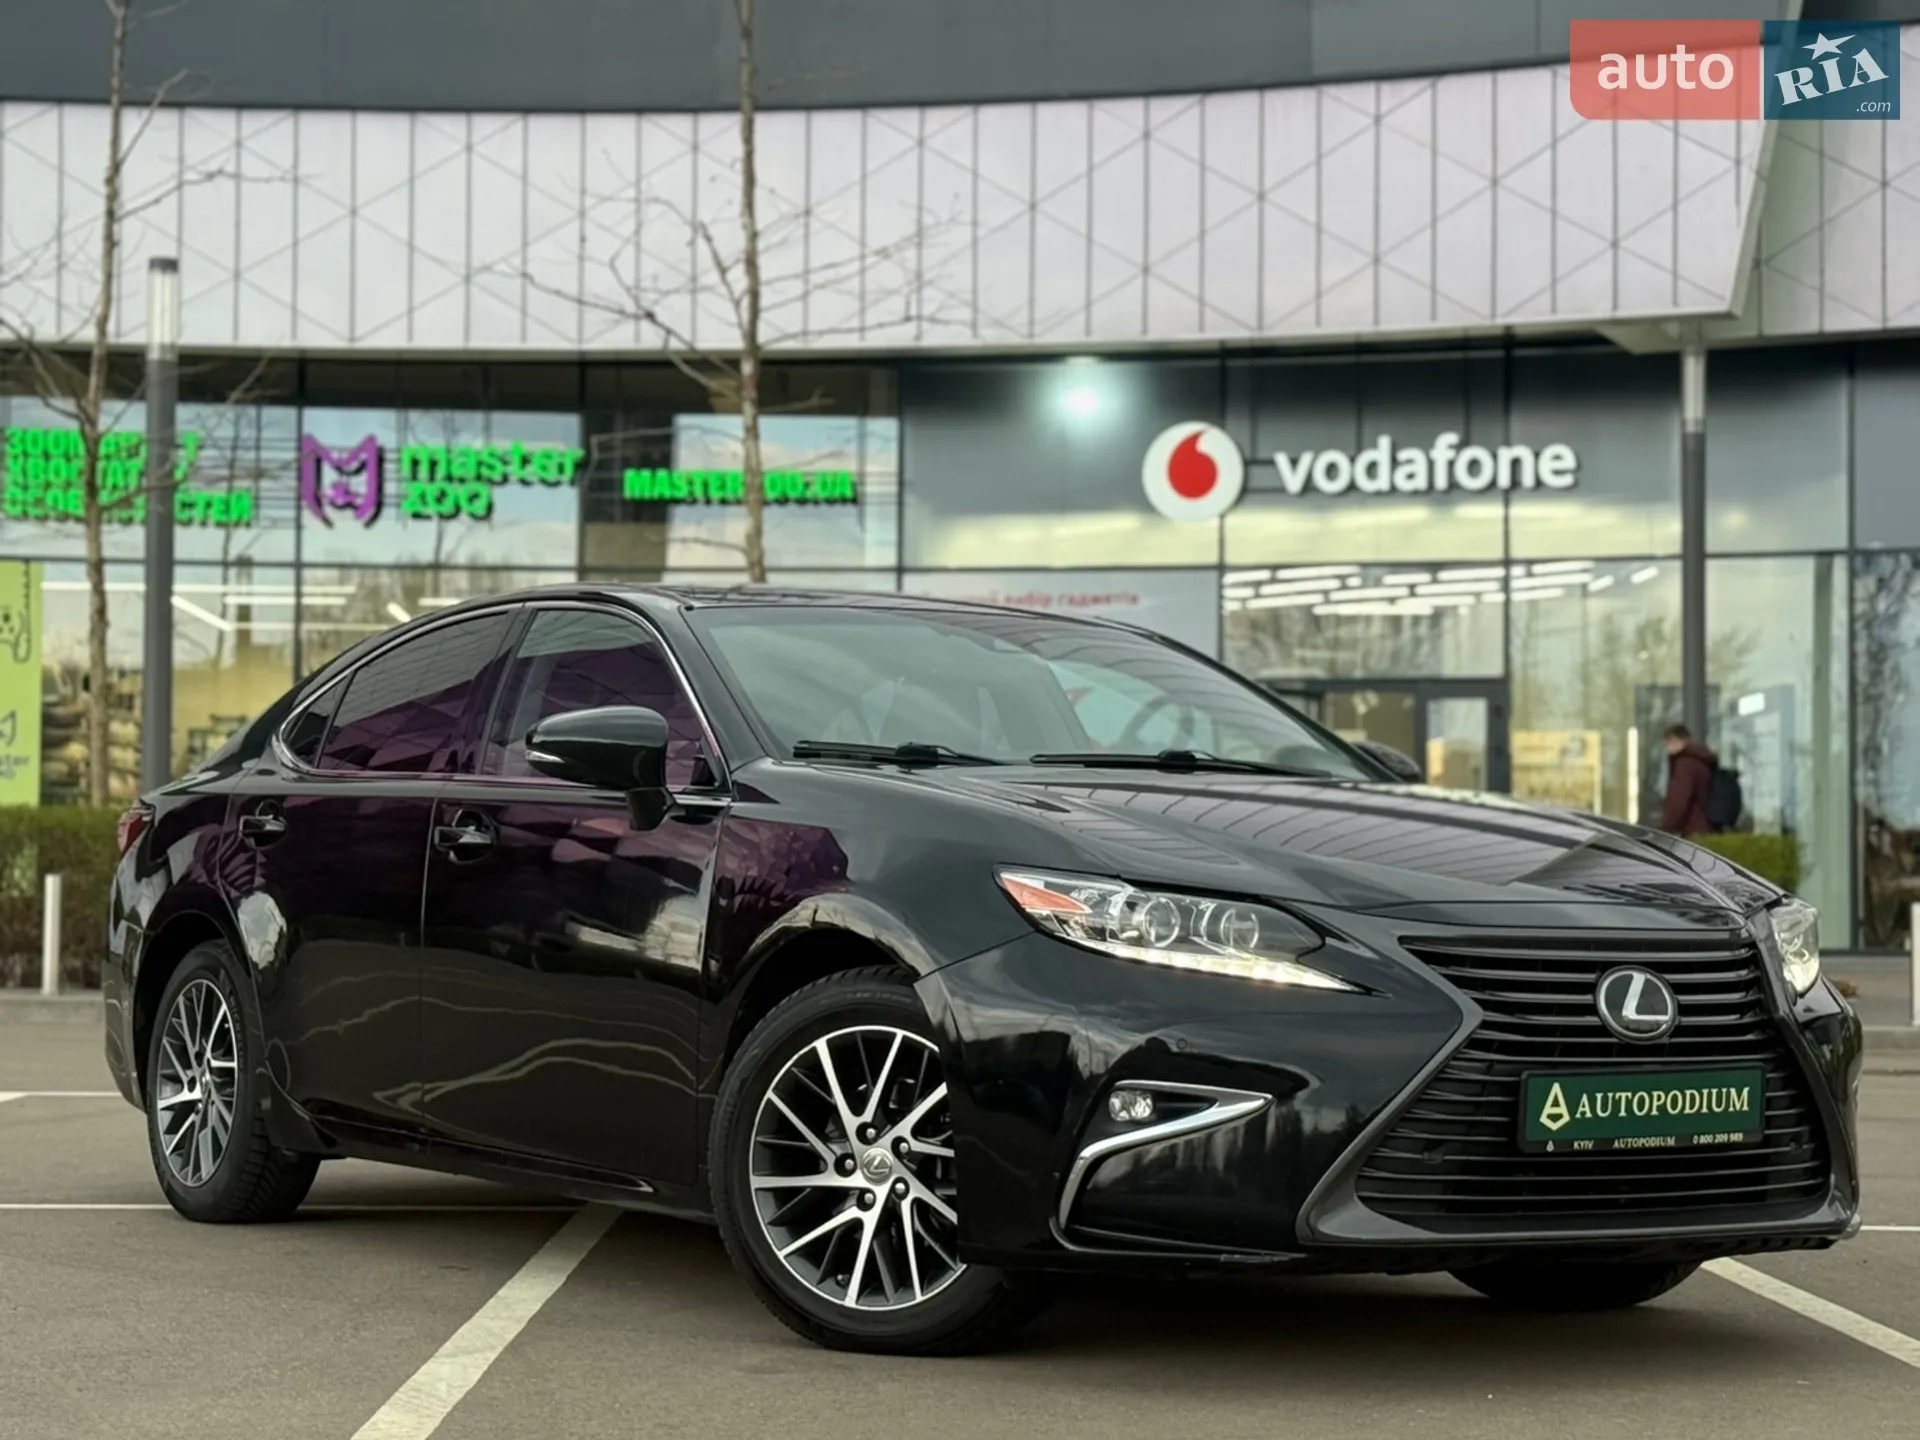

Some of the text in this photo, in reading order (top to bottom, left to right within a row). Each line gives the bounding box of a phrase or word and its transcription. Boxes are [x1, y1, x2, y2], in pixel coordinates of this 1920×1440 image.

[402, 440, 585, 481] master
[1273, 431, 1578, 495] vodafone
[623, 468, 856, 500] MASTEROO.UA
[1575, 1087, 1750, 1118] AUTOPODIUM
[1573, 1140, 1594, 1150] KYIV
[1613, 1136, 1676, 1149] AUTOPODIUM
